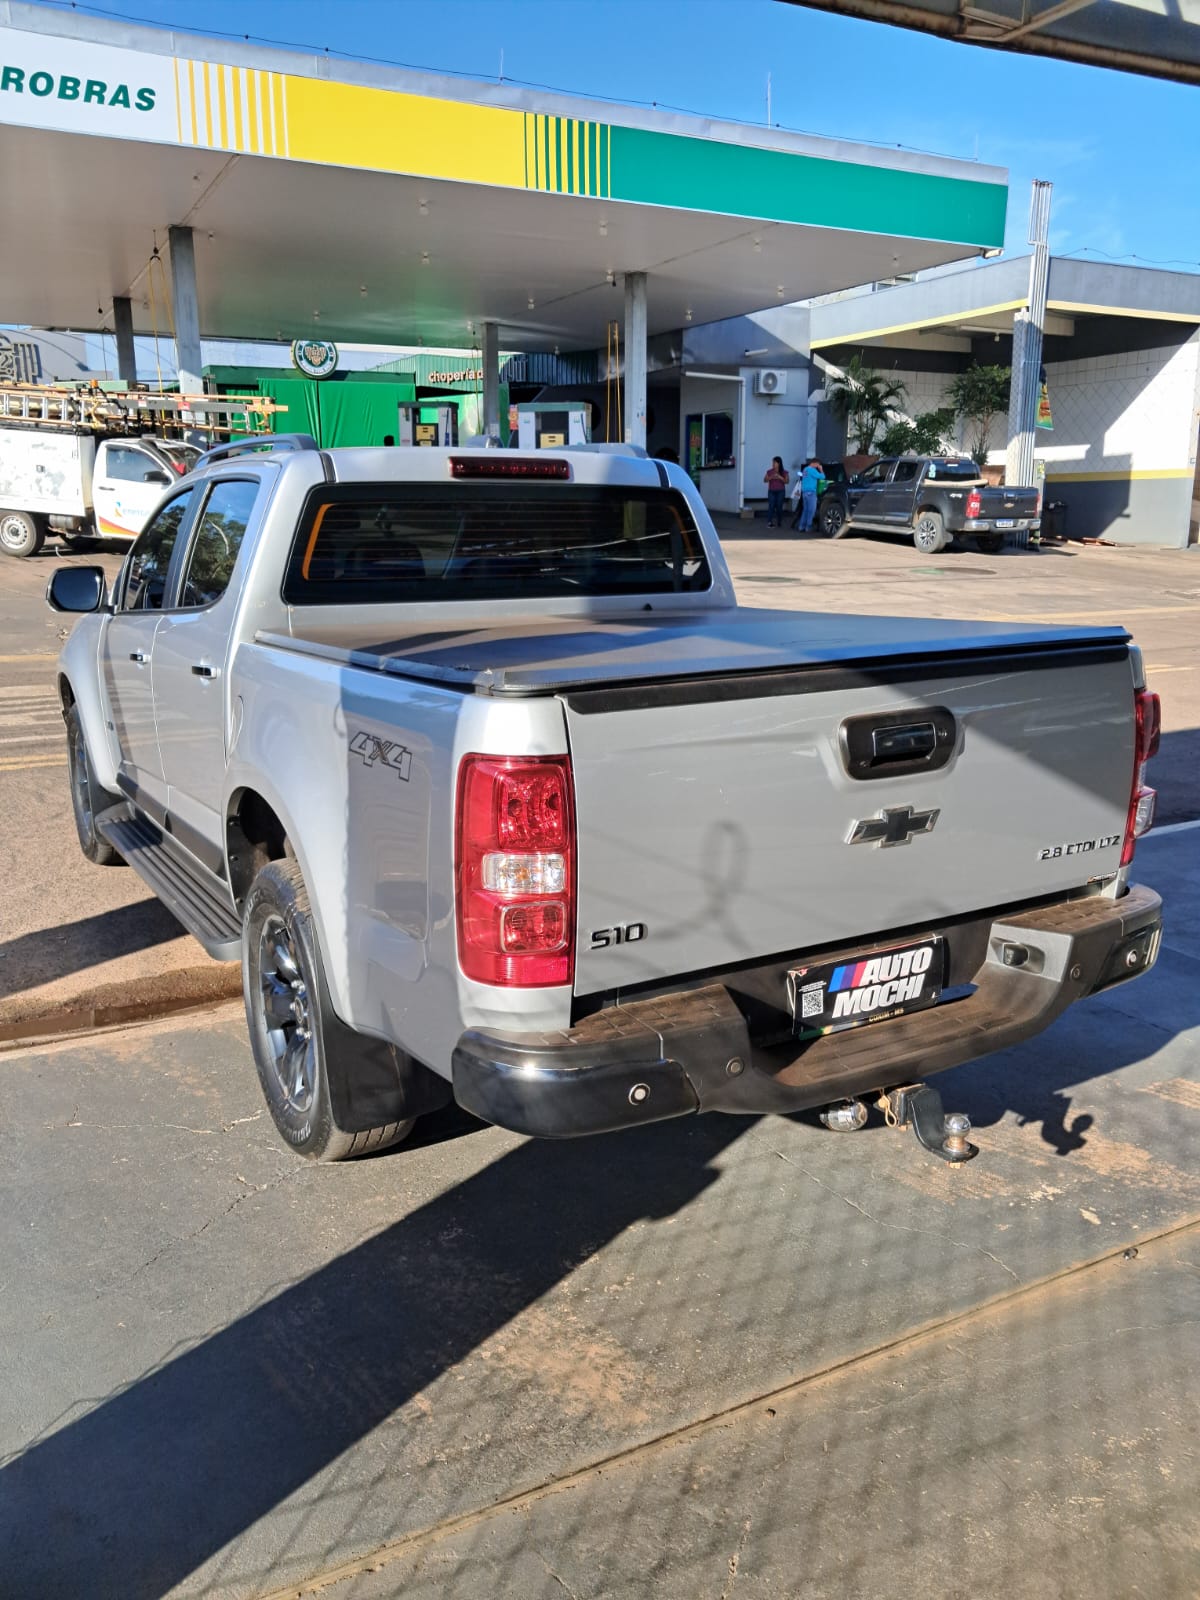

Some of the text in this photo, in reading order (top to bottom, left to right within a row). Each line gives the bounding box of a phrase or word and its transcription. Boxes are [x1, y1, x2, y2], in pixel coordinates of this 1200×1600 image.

[0, 65, 156, 112] ROBRAS
[1040, 835, 1120, 860] 2.8 CTDI LTZ
[591, 922, 646, 950] S10
[858, 947, 933, 986] AUTO
[832, 973, 926, 1018] MOCHI
